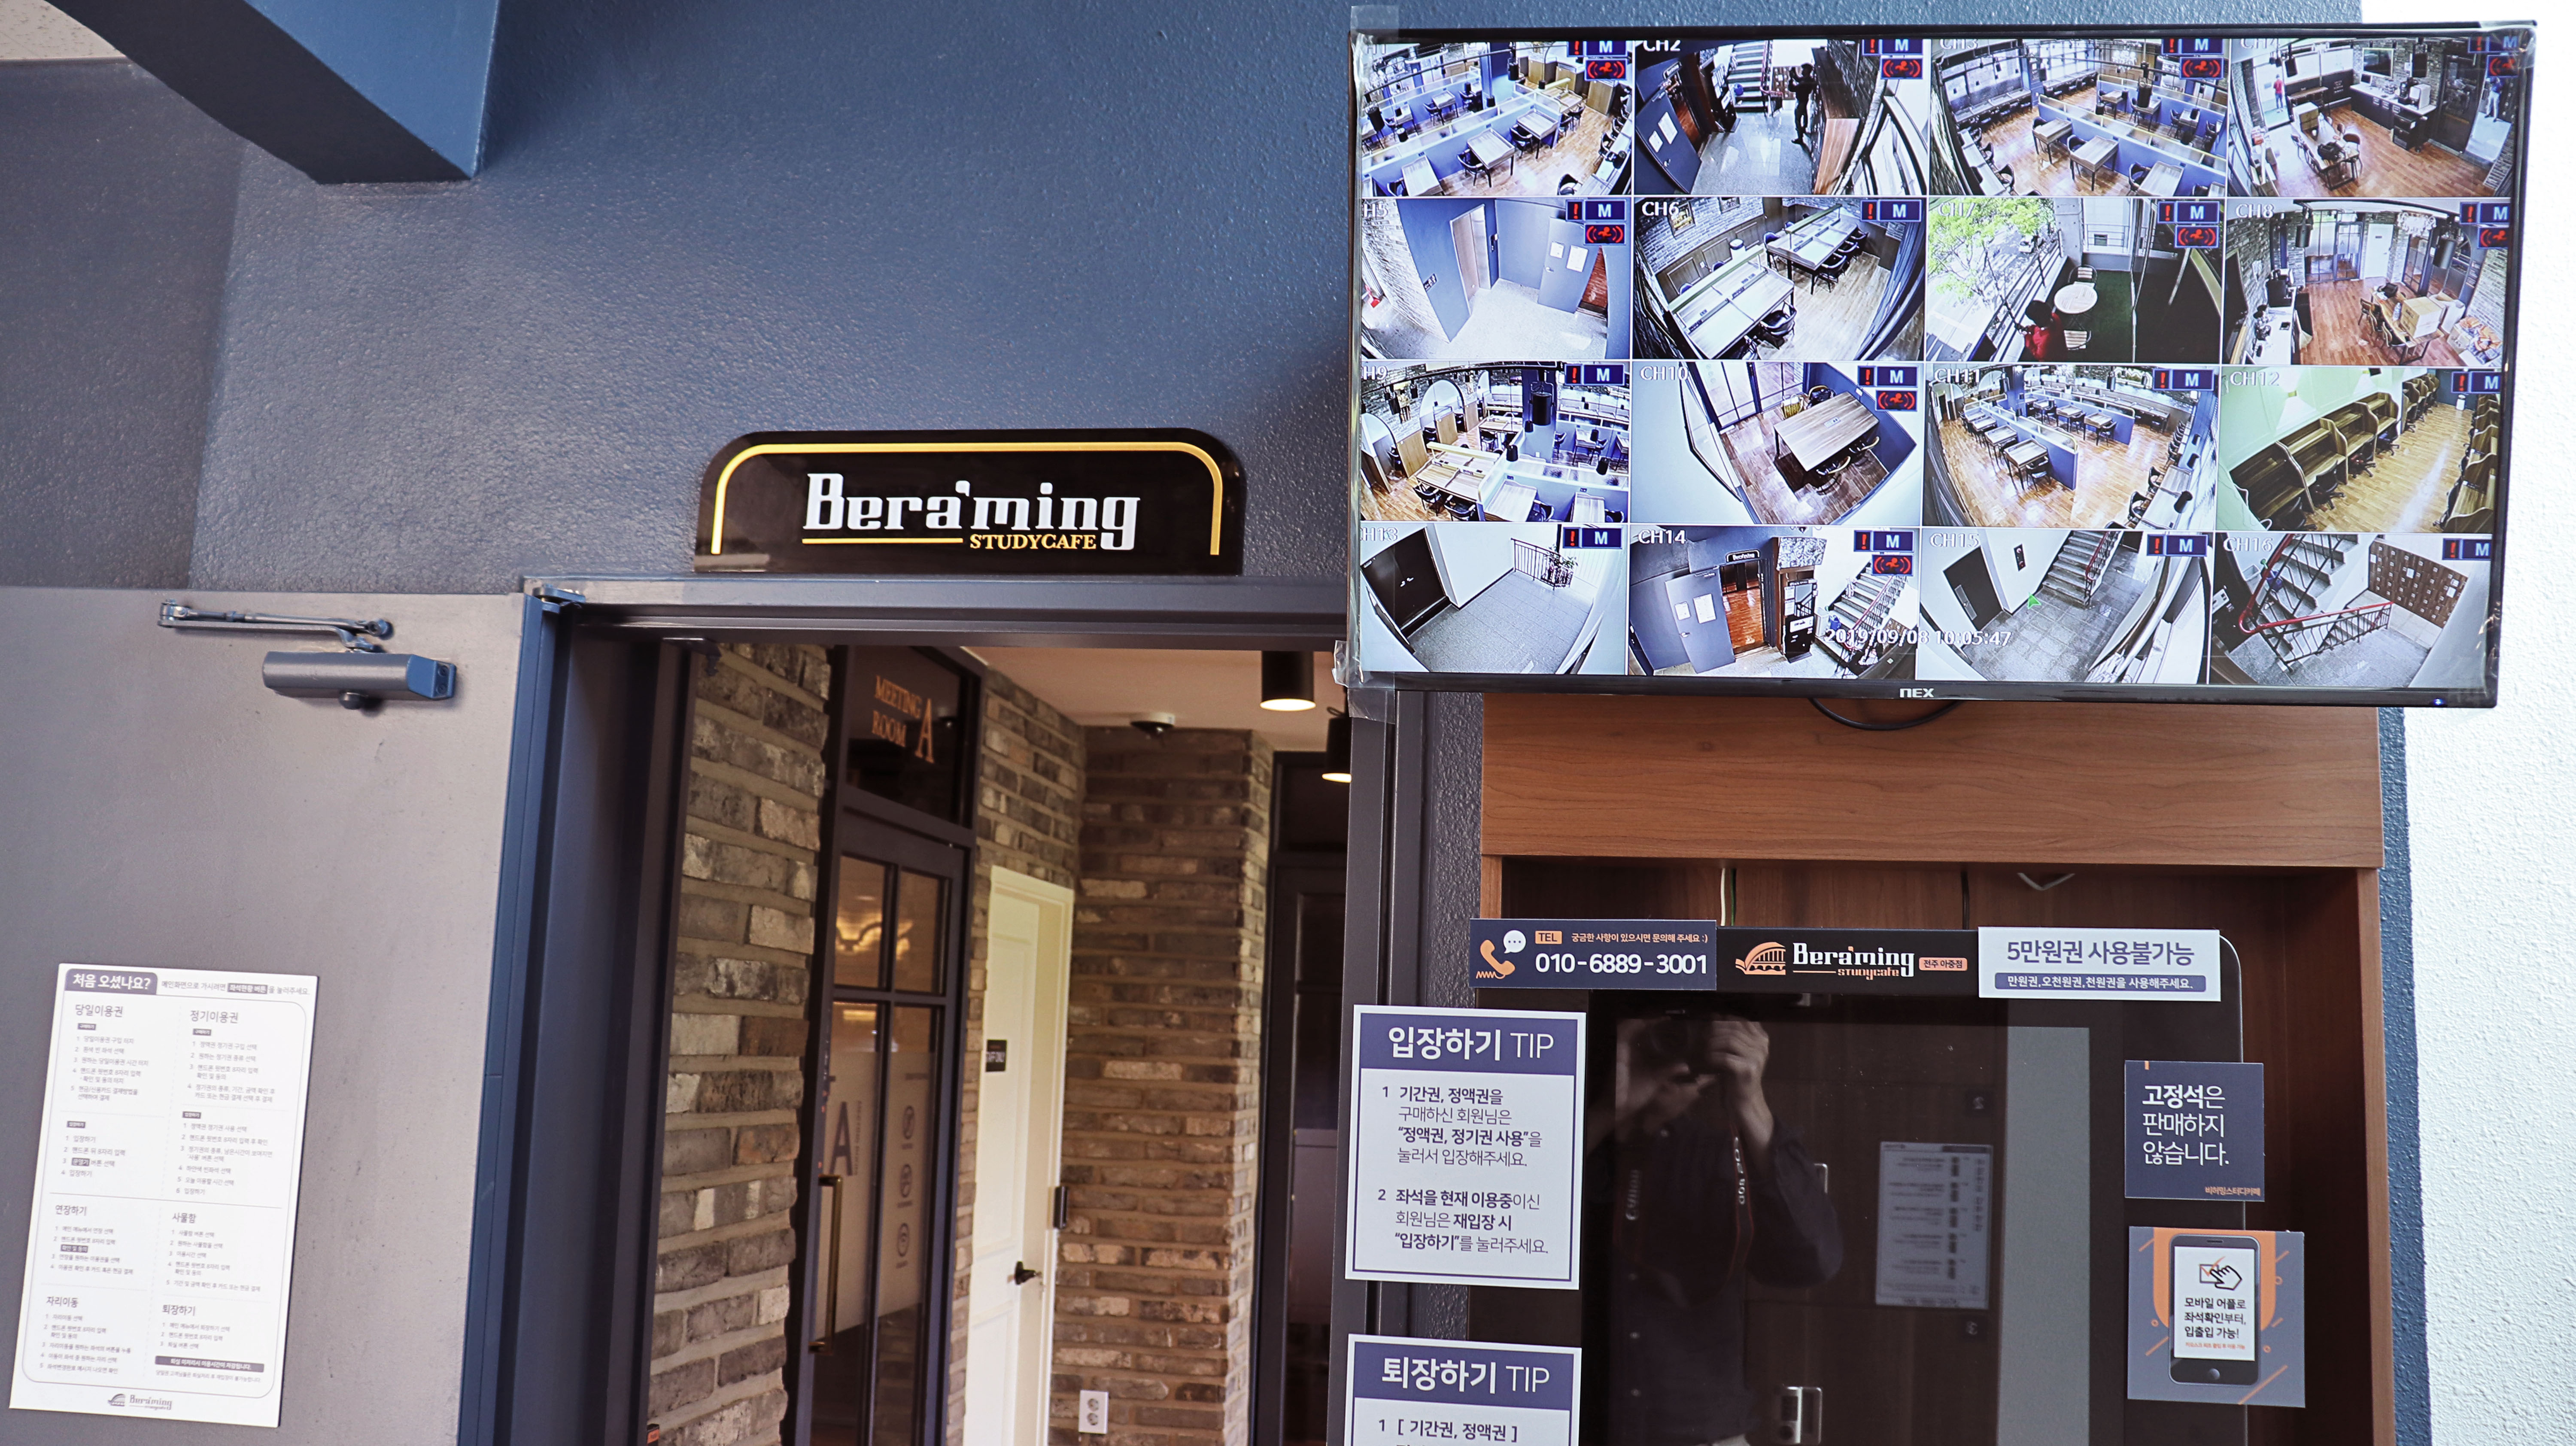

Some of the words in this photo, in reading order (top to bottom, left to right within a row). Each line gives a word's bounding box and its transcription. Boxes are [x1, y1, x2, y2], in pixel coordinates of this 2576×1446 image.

[1599, 41, 1613, 53] M
[1643, 40, 1681, 52] CH2
[1894, 39, 1910, 52] M
[2194, 39, 2210, 52] M
[1363, 203, 1388, 217] H5
[1598, 203, 1612, 217] M
[1641, 201, 1680, 217] CH6
[1892, 204, 1907, 219] M
[2190, 205, 2204, 220] M
[2235, 203, 2275, 219] CH8
[2493, 206, 2508, 221] M
[1363, 366, 1388, 380] H9
[1596, 368, 1611, 382] M
[1640, 365, 1689, 381] CH10
[1889, 369, 1904, 384] M
[1934, 367, 1980, 383] CH11
[2184, 372, 2199, 387] M
[2230, 371, 2280, 387] CH12
[2484, 375, 2499, 390] M
[969, 534, 1097, 551] STUDYCAFE
[1594, 531, 1609, 546] M
[1637, 529, 1687, 545] CH14
[1885, 534, 1901, 549] M
[1929, 532, 1980, 548] CH15
[2223, 536, 2274, 553] CH16
[2178, 538, 2193, 553] M
[2475, 542, 2489, 557] M
[1936, 631, 2012, 647] 10:05:47
[874, 675, 922, 719] MEETING
[914, 698, 935, 764] A
[872, 710, 907, 747] ROOM
[1538, 932, 1558, 942] TEL
[1571, 933, 1595, 943] 궁금한
[1596, 933, 1619, 943] 사항이
[1620, 933, 1651, 944] 있으시면
[1652, 933, 1676, 944] 문의해
[1676, 934, 1701, 944] 주세요
[2007, 940, 2084, 964] 5만원권
[2087, 940, 2195, 966] 사용불가능
[1535, 952, 1707, 975] 010-6889-3001
[1923, 959, 1938, 970] 전주
[1940, 959, 1963, 970] 아중점
[73, 973, 96, 987] 처음
[98, 975, 151, 989] 오셨나요?
[161, 981, 198, 989] 메인화면으로
[201, 983, 225, 991] 가시려면
[2128, 976, 2194, 990] 사용해주세요.
[75, 1004, 122, 1017] 당일이용권
[190, 1010, 238, 1023] 정기이용권
[1388, 1026, 1501, 1062] 입장하기
[1510, 1032, 1555, 1059] TIP
[1382, 1086, 1389, 1098] 1
[1399, 1085, 1445, 1104] 기간권,
[1447, 1087, 1504, 1106] 정액권을
[2142, 1084, 2226, 1110] 고정석은
[1398, 1106, 1453, 1124] 구매하신
[1456, 1107, 1513, 1126] 회원님은
[2142, 1112, 2224, 1138] 판매하지
[829, 1101, 853, 1176] A
[1451, 1128, 1493, 1146] 정기권
[1397, 1147, 1438, 1164] 눌러서
[1442, 1148, 1528, 1167] 입장해주세요.
[2142, 1140, 2230, 1167] 않습니다.
[1377, 1188, 1387, 1201] 2
[1395, 1188, 1438, 1206] 좌석을
[1440, 1190, 1468, 1207] 현재
[1471, 1191, 1541, 1211] 이용중이신
[55, 1205, 86, 1215] 연장하기
[172, 1212, 196, 1223] 사물함
[1395, 1209, 1451, 1228] 회원님은
[1452, 1213, 1495, 1231] 재입장
[1498, 1215, 1513, 1231] 시
[1476, 1236, 1549, 1255] 눌러주세요.
[46, 1296, 78, 1307] 자리이동
[2184, 1297, 2214, 1309] 모바일
[2216, 1297, 2247, 1310] 어플로
[162, 1304, 195, 1315] 퇴장하기
[2184, 1311, 2247, 1325] 좌석확인부터,
[2184, 1325, 2214, 1339] 입출입
[2216, 1326, 2240, 1340] 가능!
[1381, 1356, 1497, 1395] 퇴장하기
[1505, 1365, 1550, 1393] TIP
[1378, 1419, 1386, 1432] 1
[1410, 1419, 1458, 1439] 기간권,
[1462, 1422, 1507, 1442] 정액권
